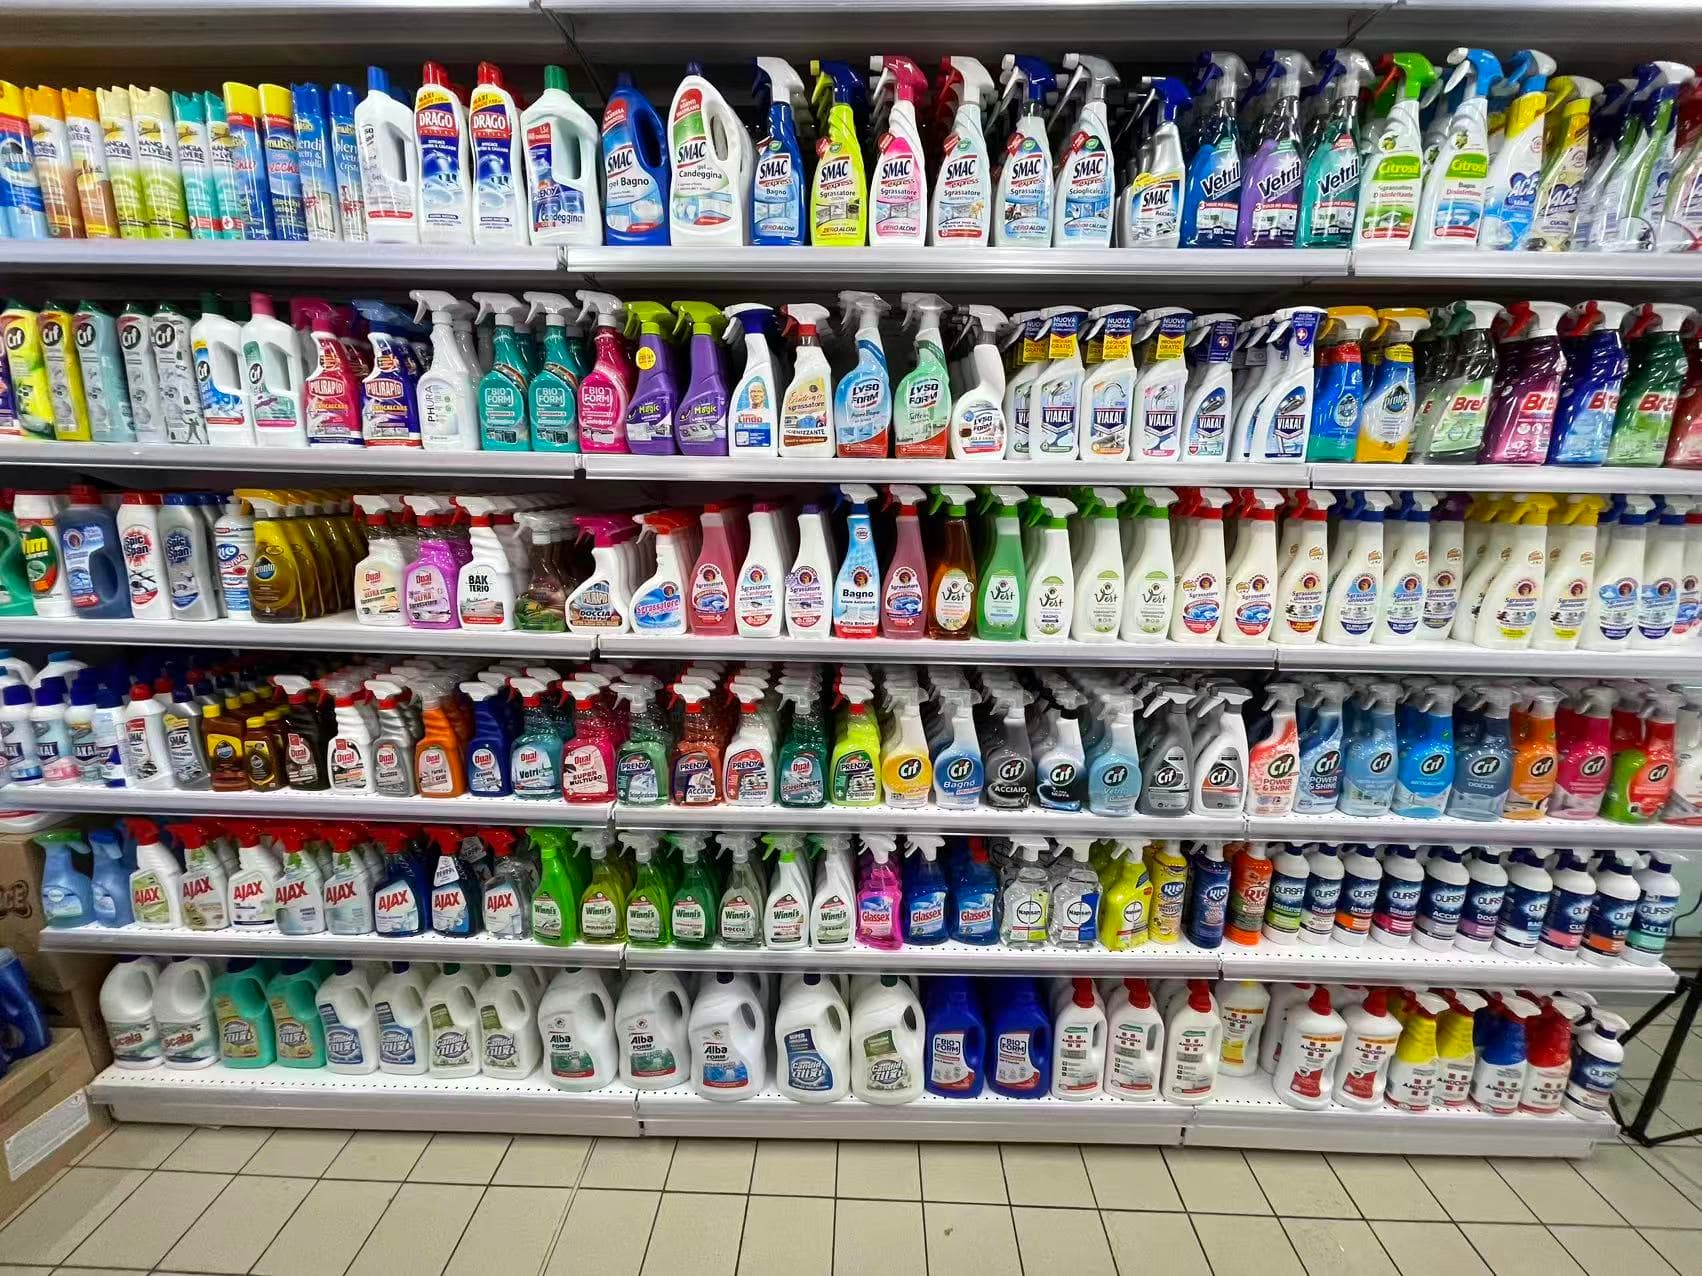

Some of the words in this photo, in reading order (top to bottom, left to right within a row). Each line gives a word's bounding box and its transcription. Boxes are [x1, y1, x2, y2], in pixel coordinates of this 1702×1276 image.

[419, 113, 453, 128] DRAGO
[474, 114, 506, 129] DRAGO
[678, 140, 706, 163] SMAC
[608, 150, 632, 172] SMAC
[760, 160, 788, 179] SMAC
[821, 161, 849, 182] SMAC
[882, 160, 910, 179] SMAC
[946, 160, 975, 179] SMAC
[1012, 159, 1041, 178] SMAC
[1073, 157, 1102, 178] SMAC
[1379, 162, 1421, 175] Citrosil
[679, 170, 722, 180] Candeggina
[1201, 161, 1240, 196] Vetril
[1258, 161, 1301, 199] Vetril
[1317, 158, 1359, 196] Vetril
[621, 177, 649, 186] Bagno
[764, 178, 792, 188] express
[826, 179, 853, 189] express
[887, 178, 915, 188] express
[952, 178, 980, 188] express
[1017, 178, 1045, 187] express
[1079, 177, 1106, 185] express
[1512, 177, 1538, 196] ACE
[766, 188, 786, 196] Bagno
[820, 190, 856, 198] Sgrassatore
[881, 188, 917, 196] Sgrassatore
[944, 189, 980, 197] Sgrassatore
[1551, 187, 1578, 205] ACE
[1143, 190, 1170, 208] SMAC
[7, 333, 22, 346] Cif
[366, 382, 402, 395] PULIRAPID
[491, 387, 505, 395] BIO
[542, 387, 557, 395] BIO
[853, 384, 879, 395] LYSO
[910, 384, 938, 395] LYSO
[487, 394, 512, 403] FORM
[538, 394, 563, 403] FORM
[585, 394, 610, 402] FORM
[852, 392, 879, 404] FORM
[909, 391, 938, 405] FORM
[1452, 395, 1487, 412] Bref
[639, 404, 660, 414] Magic
[694, 405, 717, 415] Magic
[738, 414, 762, 422] Lindo
[974, 415, 993, 425] LYSO
[1045, 410, 1071, 423] VIAKAL
[1096, 411, 1122, 424] VIAKAL
[1148, 413, 1174, 426] VIAKAL
[1200, 417, 1223, 429] VIAKAL
[1276, 417, 1301, 430] VIAKAL
[124, 536, 143, 545] Spic
[167, 536, 186, 546] Spic
[124, 545, 149, 556] Span
[167, 546, 191, 557] Span
[416, 573, 431, 584] Dual
[469, 575, 488, 585] BAK
[789, 585, 821, 594] Sgrassatore
[842, 588, 874, 598] Bagno
[942, 586, 967, 601] Vest
[990, 586, 1015, 602] Vest
[1039, 592, 1064, 608] Vest
[1095, 590, 1118, 604] Vest
[1142, 590, 1167, 604] Vest
[580, 610, 611, 618] DOCCIA
[170, 734, 188, 745] SMAC
[475, 754, 491, 764] Dual
[520, 752, 537, 761] Dual
[574, 754, 591, 764] Dual
[621, 761, 647, 770] PRENDY
[679, 761, 707, 771] PRENDY
[732, 760, 760, 770] PRENDY
[793, 761, 809, 772] Dual
[841, 761, 869, 770] PRENDY
[1270, 759, 1292, 775] Cif
[1315, 755, 1338, 773] Cif
[1422, 759, 1443, 772] Cif
[1532, 760, 1551, 773] Cif
[519, 769, 538, 779] Vetri
[572, 771, 598, 779] SUPER
[900, 763, 920, 778] Cif
[950, 763, 970, 777] Cif
[1001, 764, 1022, 778] Cif
[1052, 769, 1073, 782] Cif
[569, 774, 602, 785] MULTIUSO
[1105, 770, 1125, 783] Cif
[1158, 770, 1174, 784] Cif
[1210, 770, 1226, 784] Cif
[1309, 776, 1338, 784] POWER
[943, 779, 976, 788] Bagno
[995, 786, 1027, 794] ACCIAIO
[182, 875, 213, 898] AJAX
[233, 880, 264, 900] AJAX
[275, 881, 308, 903] AJAX
[134, 887, 160, 904] AJAX
[325, 881, 357, 904] AJAX
[378, 890, 408, 912] AJAX
[434, 891, 460, 910] AJAX
[487, 893, 512, 911] AJAX
[585, 905, 612, 915] Winni's
[630, 909, 655, 919] Winni's
[676, 909, 700, 919] Winni's
[725, 910, 751, 920] Winni's
[773, 910, 800, 920] Winni's
[821, 910, 847, 921] Winni's
[912, 909, 942, 922] Glassex
[961, 909, 991, 921] Glassex
[862, 910, 890, 922] Glassex
[1223, 1016, 1252, 1025] AMUCHINA
[550, 1033, 571, 1044] Alba
[631, 1034, 654, 1044] Alba
[704, 1045, 728, 1055] Alba
[1301, 1044, 1331, 1052] AMUCHINA
